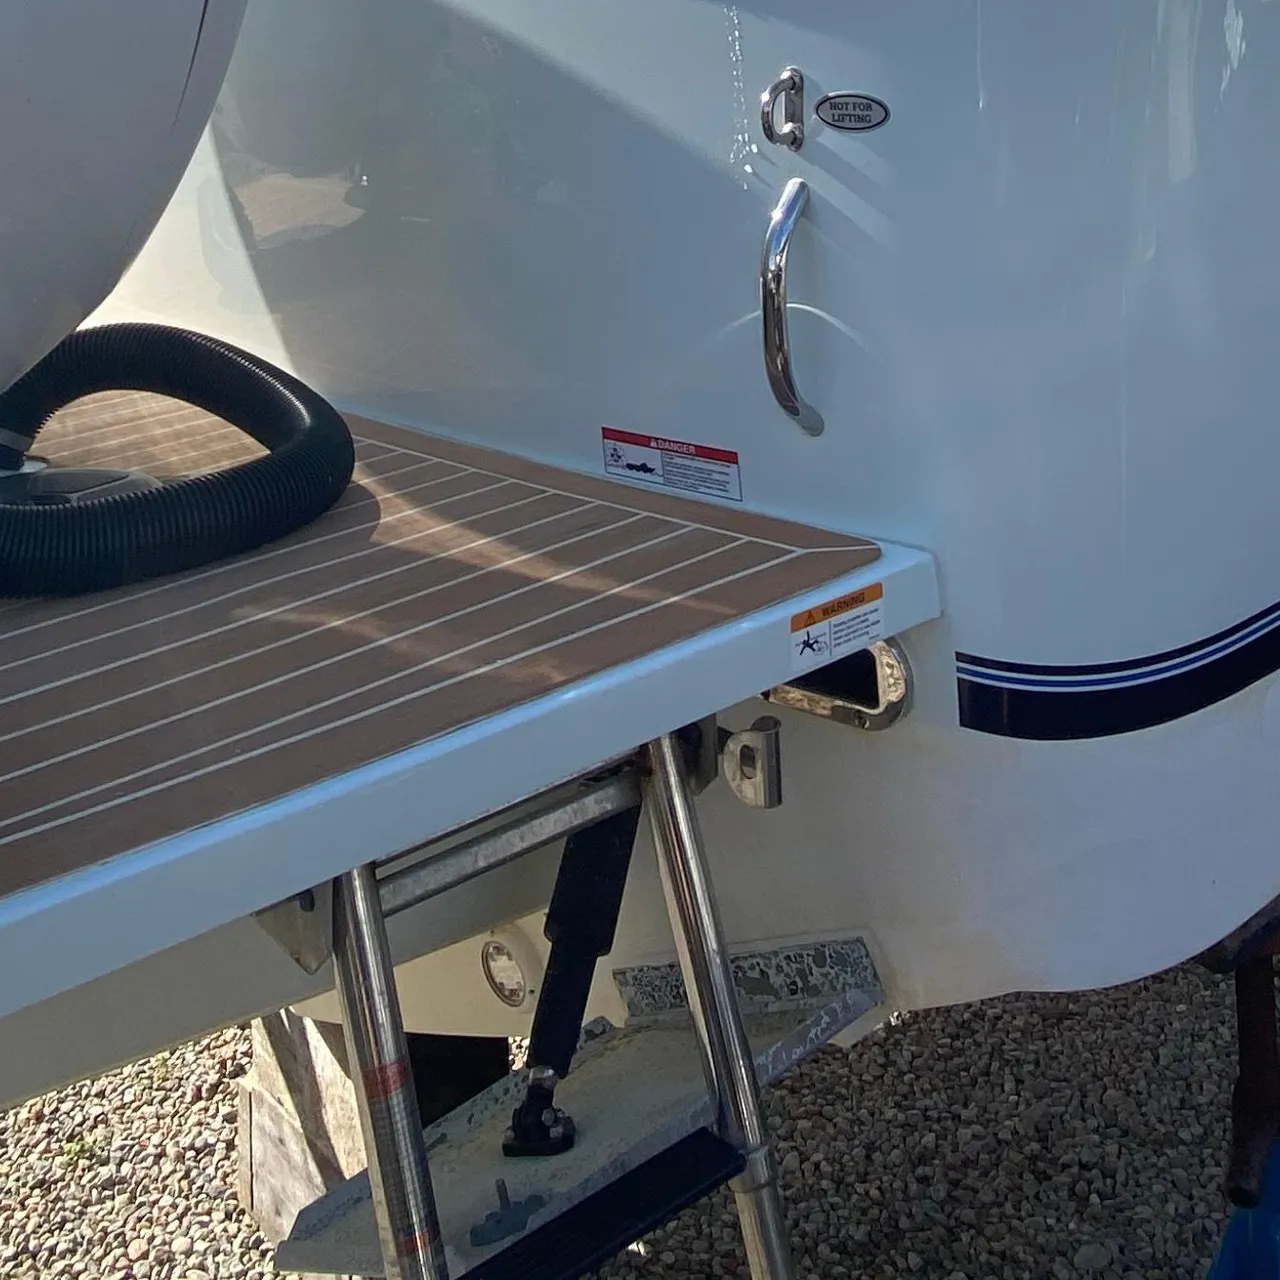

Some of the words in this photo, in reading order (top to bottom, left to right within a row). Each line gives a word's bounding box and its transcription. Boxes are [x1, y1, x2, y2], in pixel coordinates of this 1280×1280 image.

[829, 102, 849, 111] NOT
[852, 102, 873, 112] FOR
[832, 113, 872, 124] LIFTING
[657, 439, 696, 455] DANGER
[822, 592, 865, 617] WARNING
